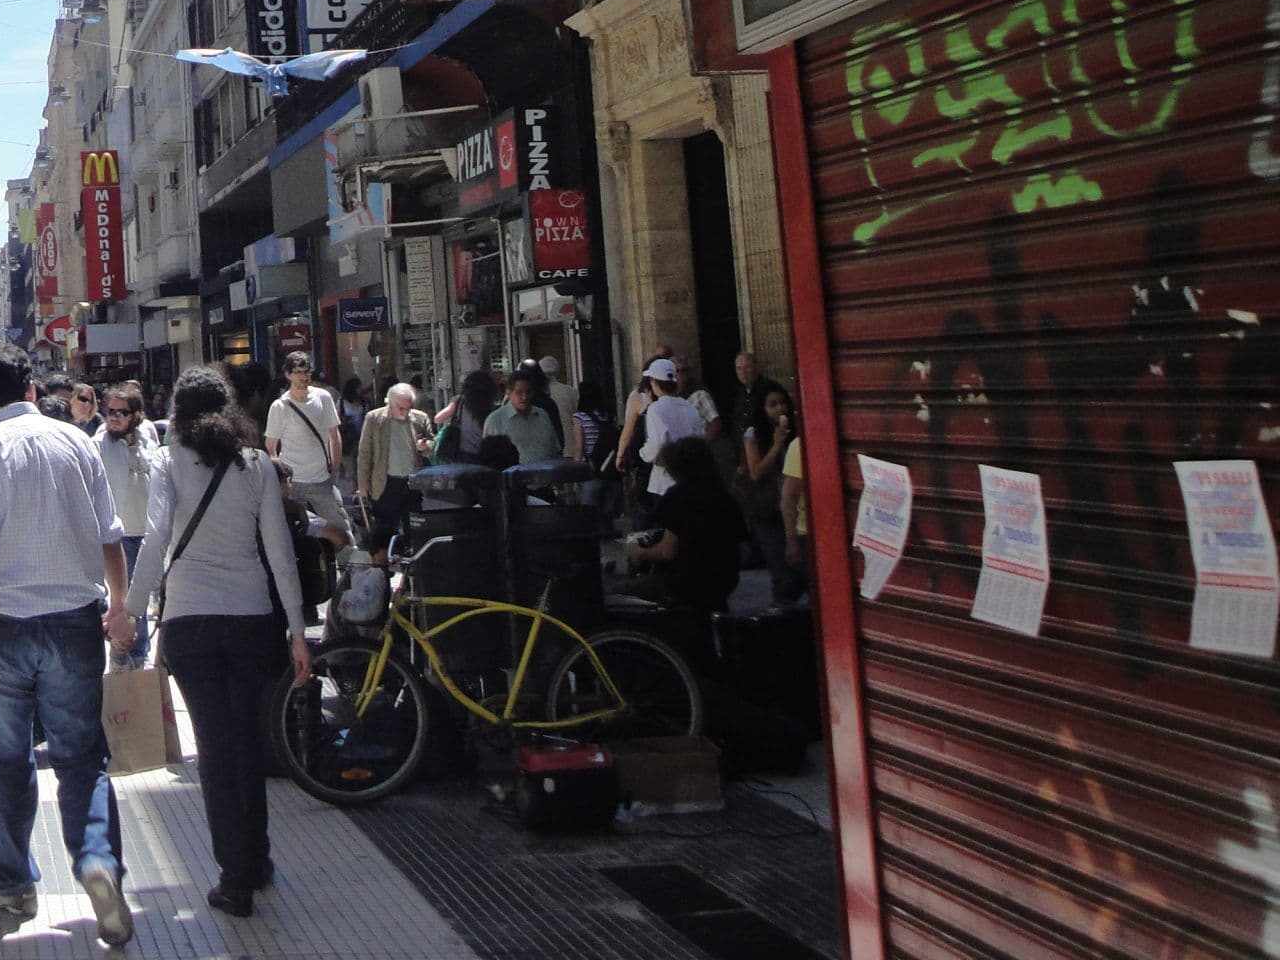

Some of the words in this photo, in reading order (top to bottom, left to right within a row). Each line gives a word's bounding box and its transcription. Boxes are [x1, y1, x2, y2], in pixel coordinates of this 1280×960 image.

[456, 128, 494, 184] PIZZA
[524, 109, 552, 191] PIZZA
[94, 189, 117, 299] McDonald's
[535, 226, 585, 242] PIZZA
[538, 267, 589, 279] CAFE
